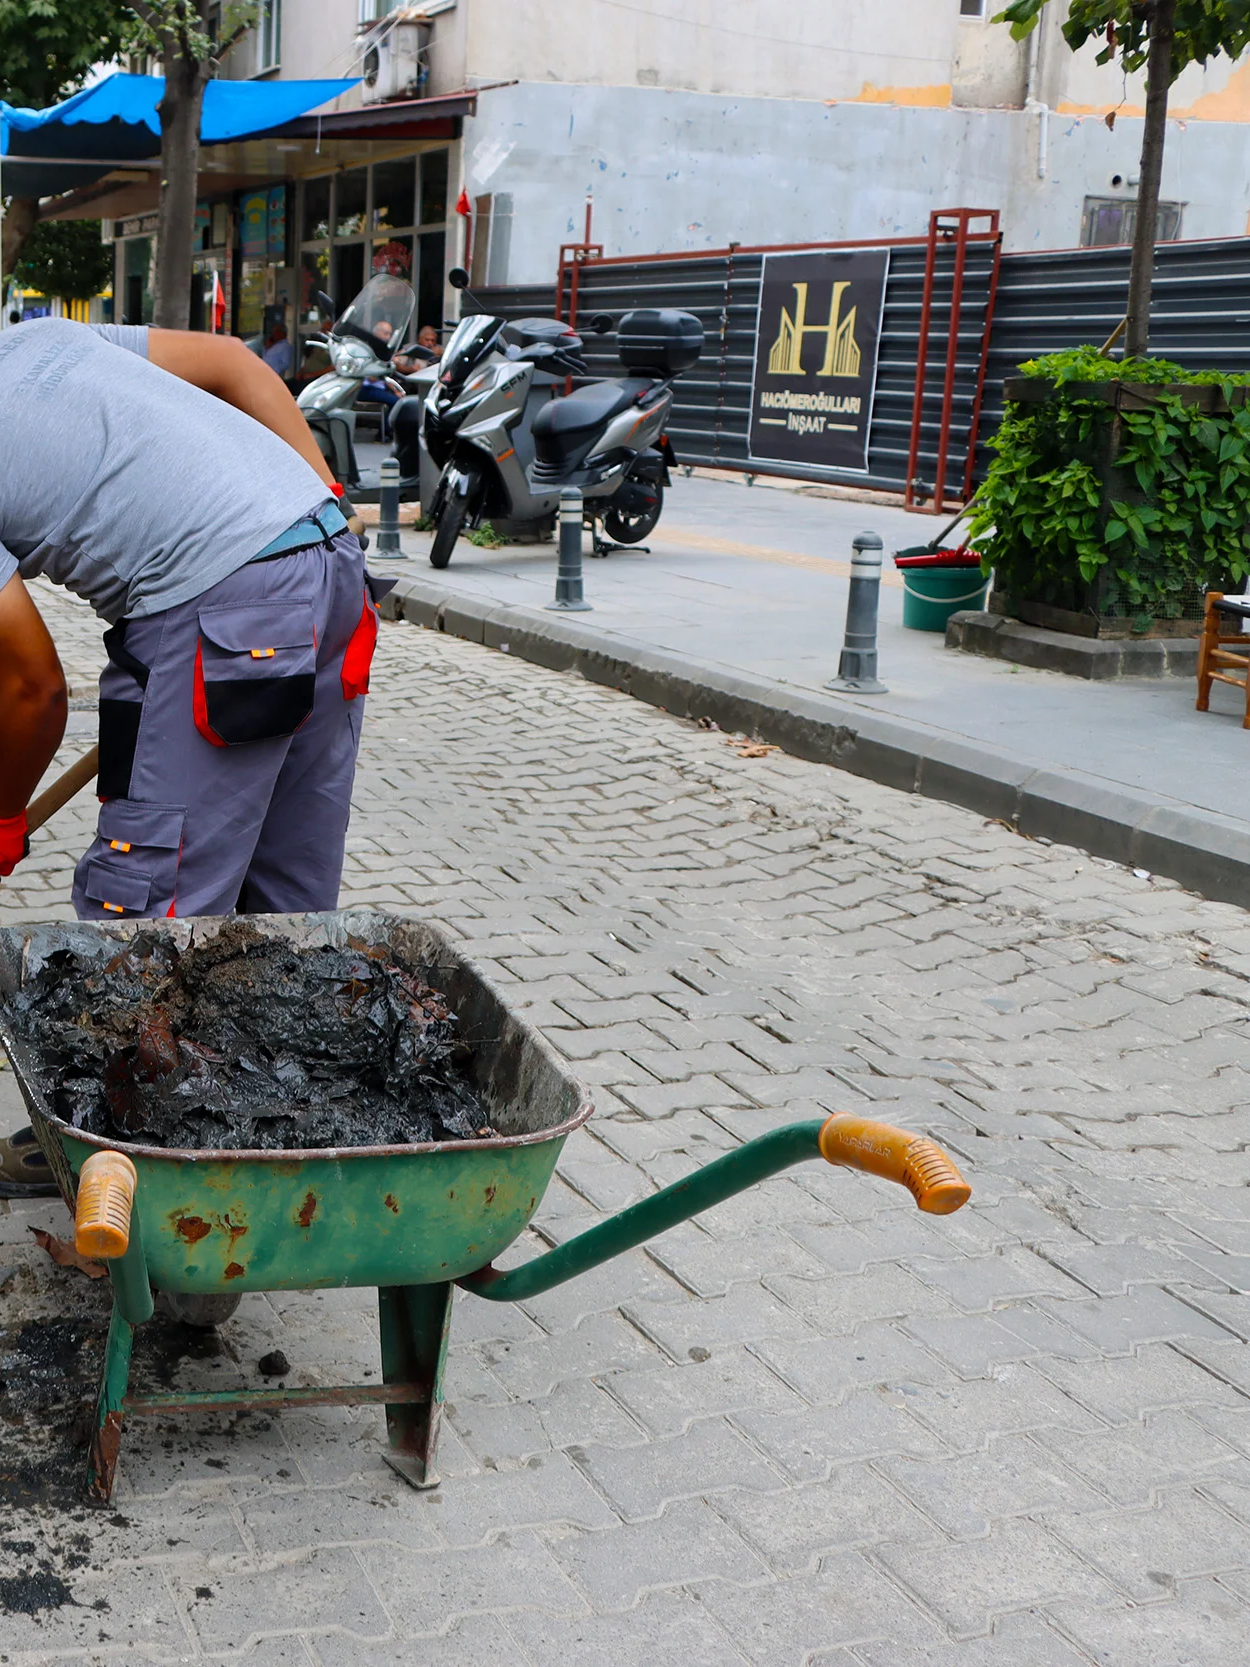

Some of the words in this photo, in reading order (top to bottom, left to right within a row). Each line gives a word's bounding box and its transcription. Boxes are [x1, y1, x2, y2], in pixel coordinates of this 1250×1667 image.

[500, 370, 527, 392] SFM
[760, 389, 862, 414] HACIÖMEROĞULLARI
[787, 411, 827, 436] İNŞAAT
